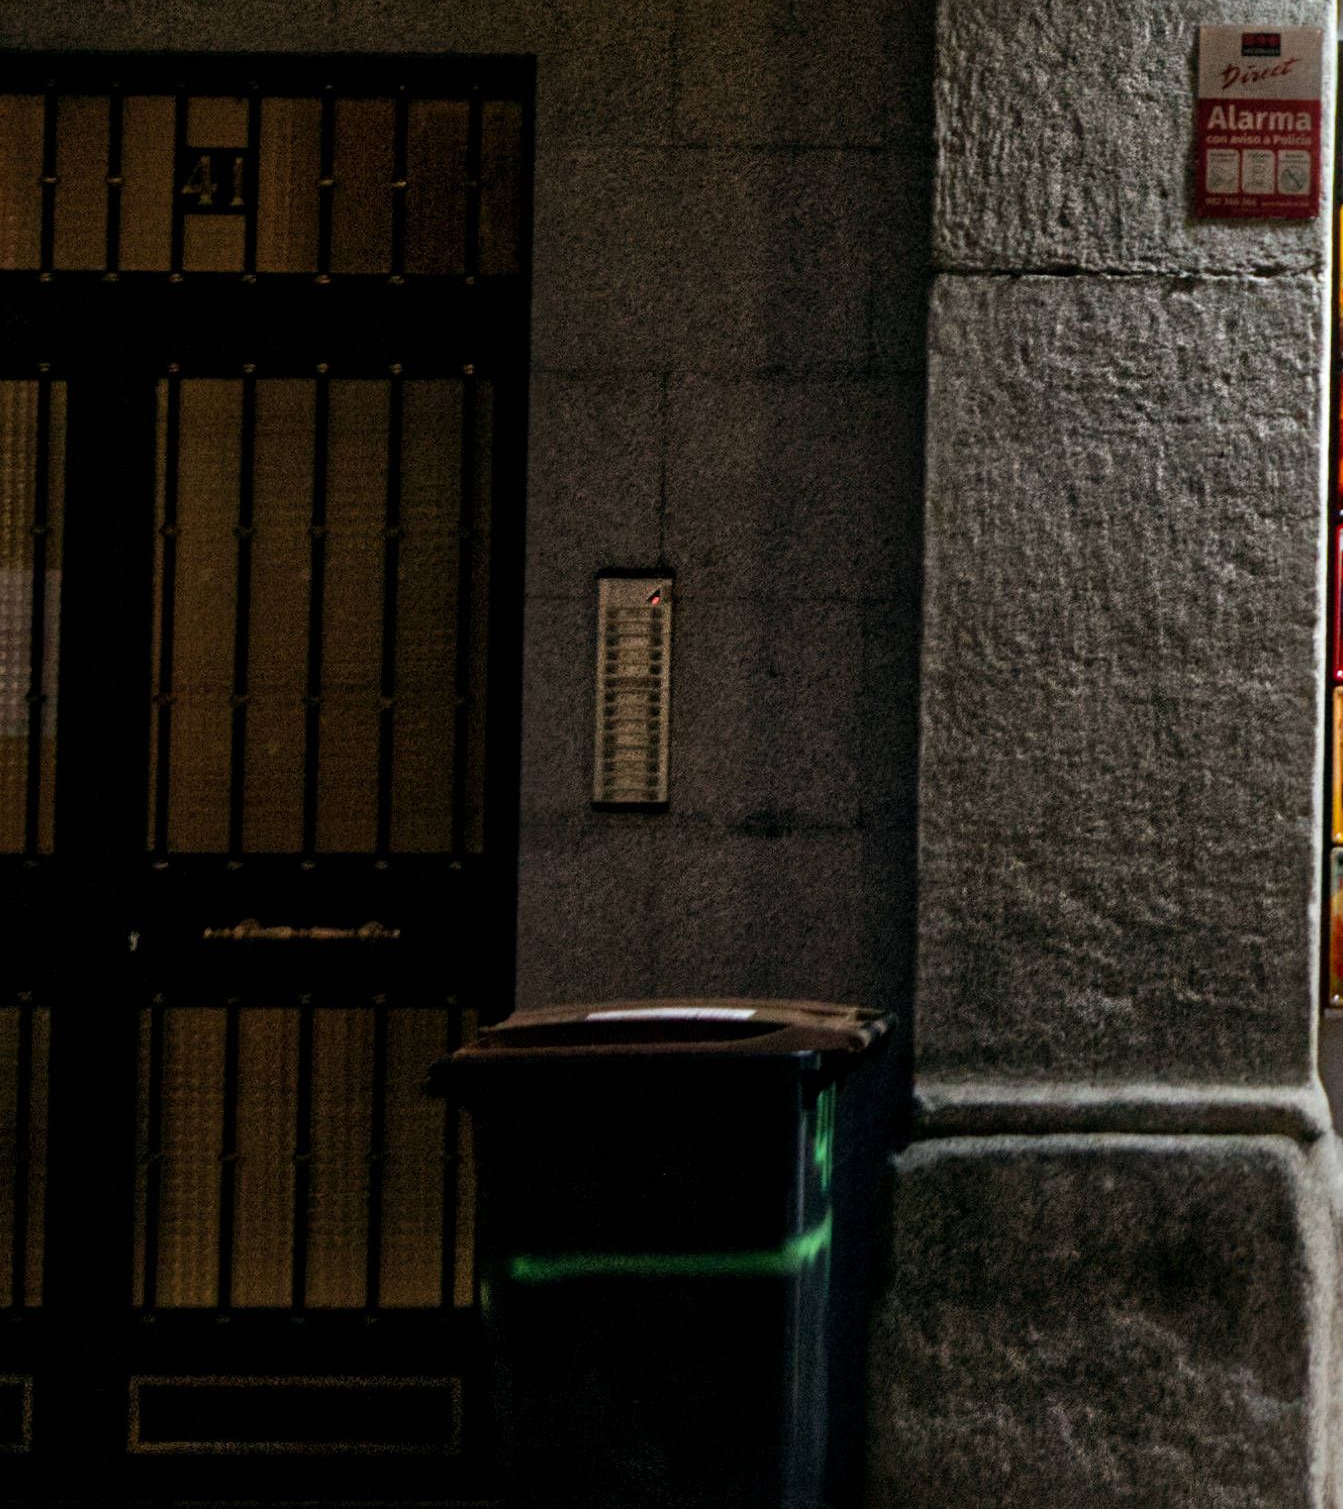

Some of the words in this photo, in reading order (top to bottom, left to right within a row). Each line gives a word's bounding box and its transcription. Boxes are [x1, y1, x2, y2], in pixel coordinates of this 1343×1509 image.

[1220, 57, 1301, 90] Direct
[1207, 105, 1312, 132] Alarma
[180, 155, 245, 207] 41
